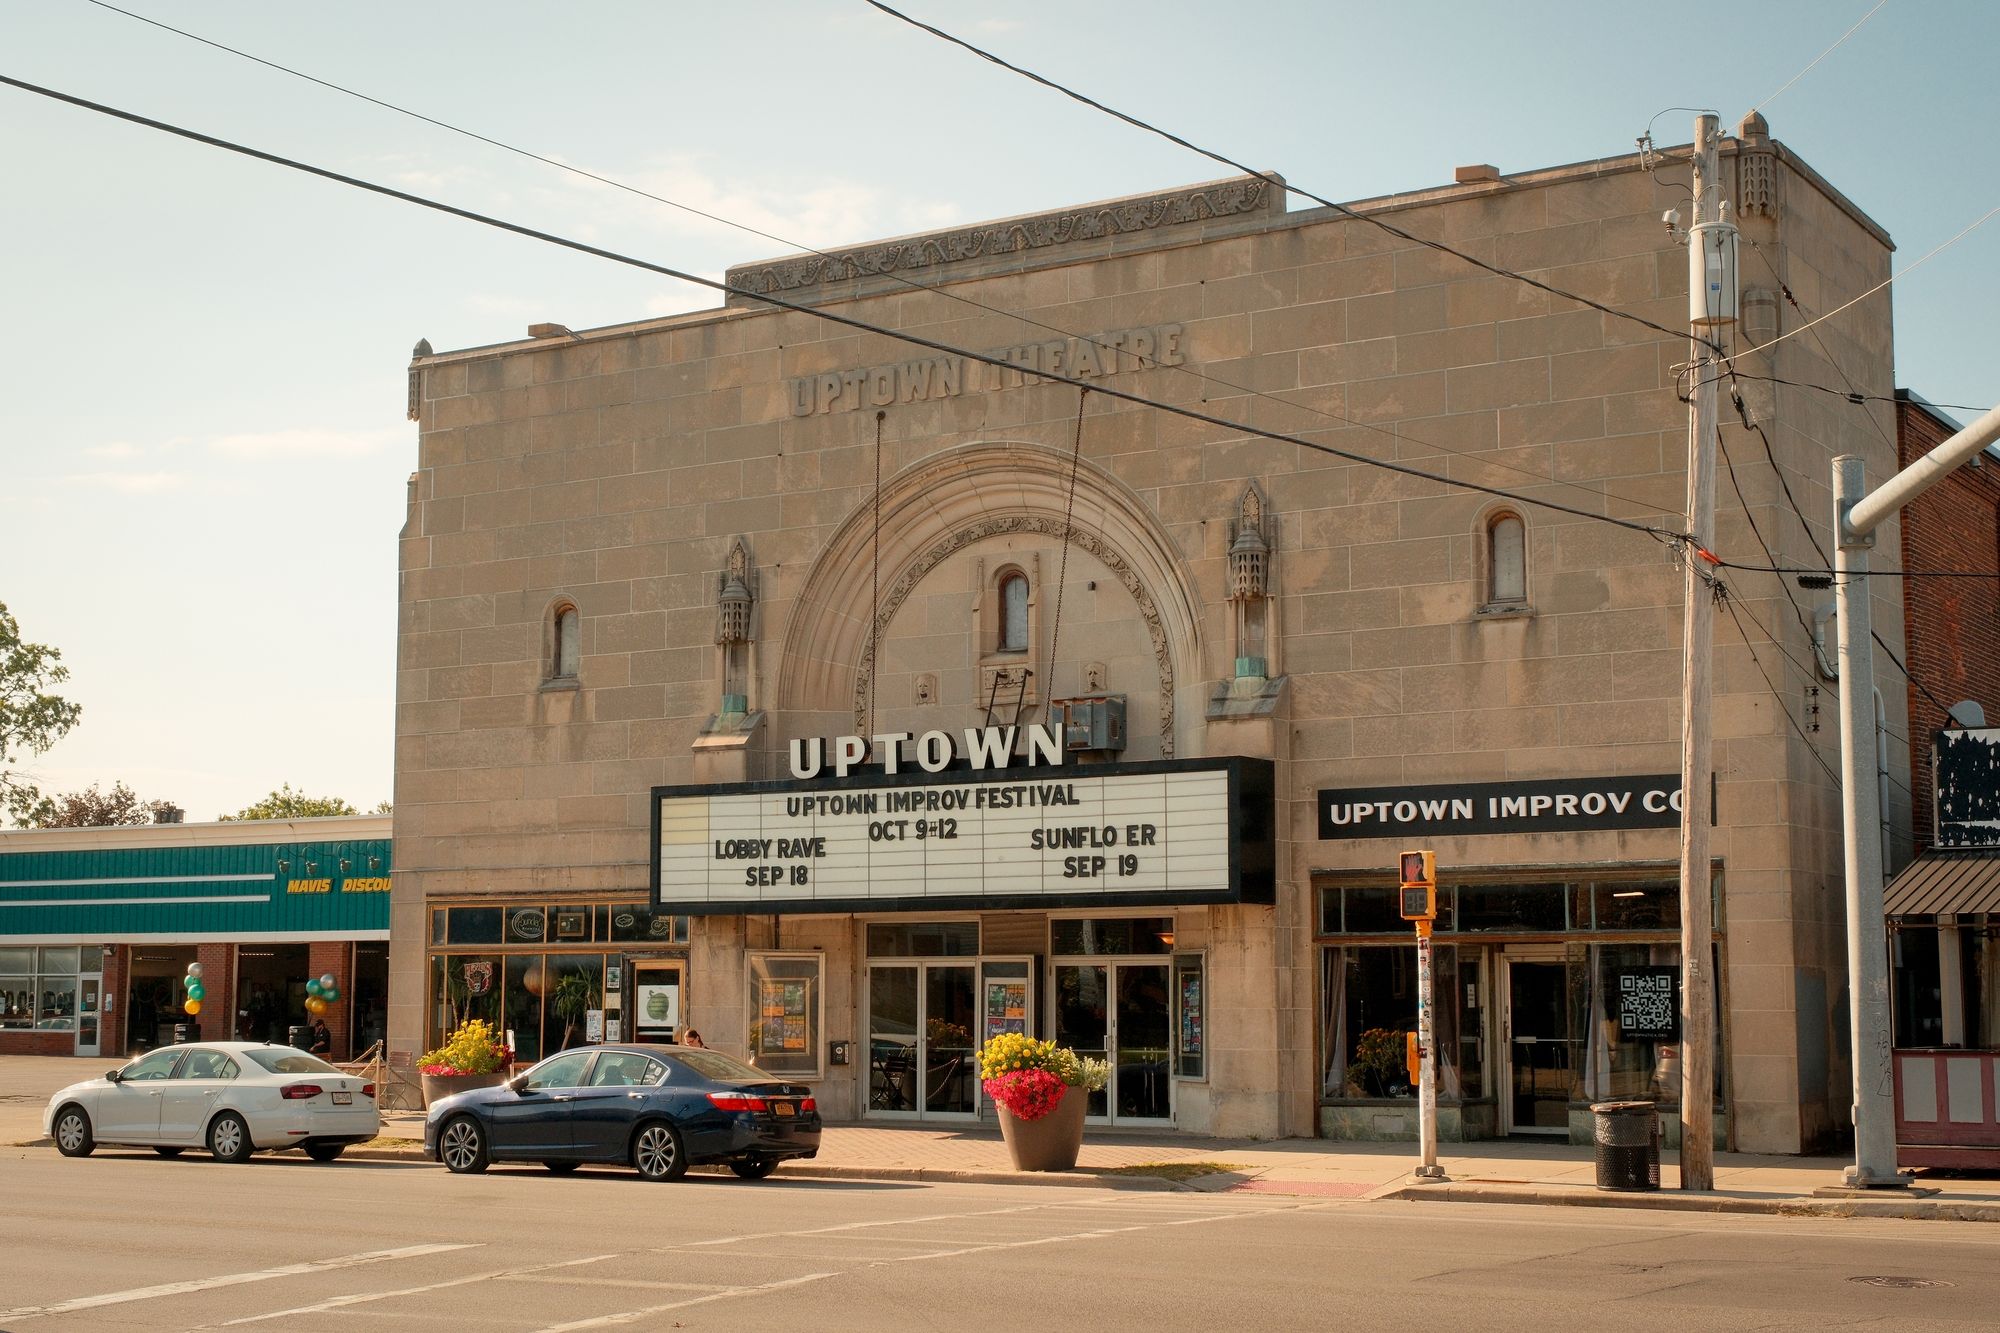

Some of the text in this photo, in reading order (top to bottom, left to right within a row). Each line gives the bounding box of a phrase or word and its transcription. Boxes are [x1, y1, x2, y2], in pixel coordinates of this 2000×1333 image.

[788, 324, 1184, 417] UPTOWN THEATRE
[789, 722, 1067, 779] UPTOWN
[787, 784, 1080, 817] UPTOWN IMPROV FESTIVAL
[1330, 799, 1473, 826] UPTOWN
[1489, 791, 1632, 819] IMPROV
[869, 820, 908, 842] OCT
[716, 837, 826, 860] LOBBY RAVE
[745, 865, 808, 886] SEP 18
[1063, 854, 1139, 878] SEP 19
[287, 878, 391, 894] MAVIS DISCOU
